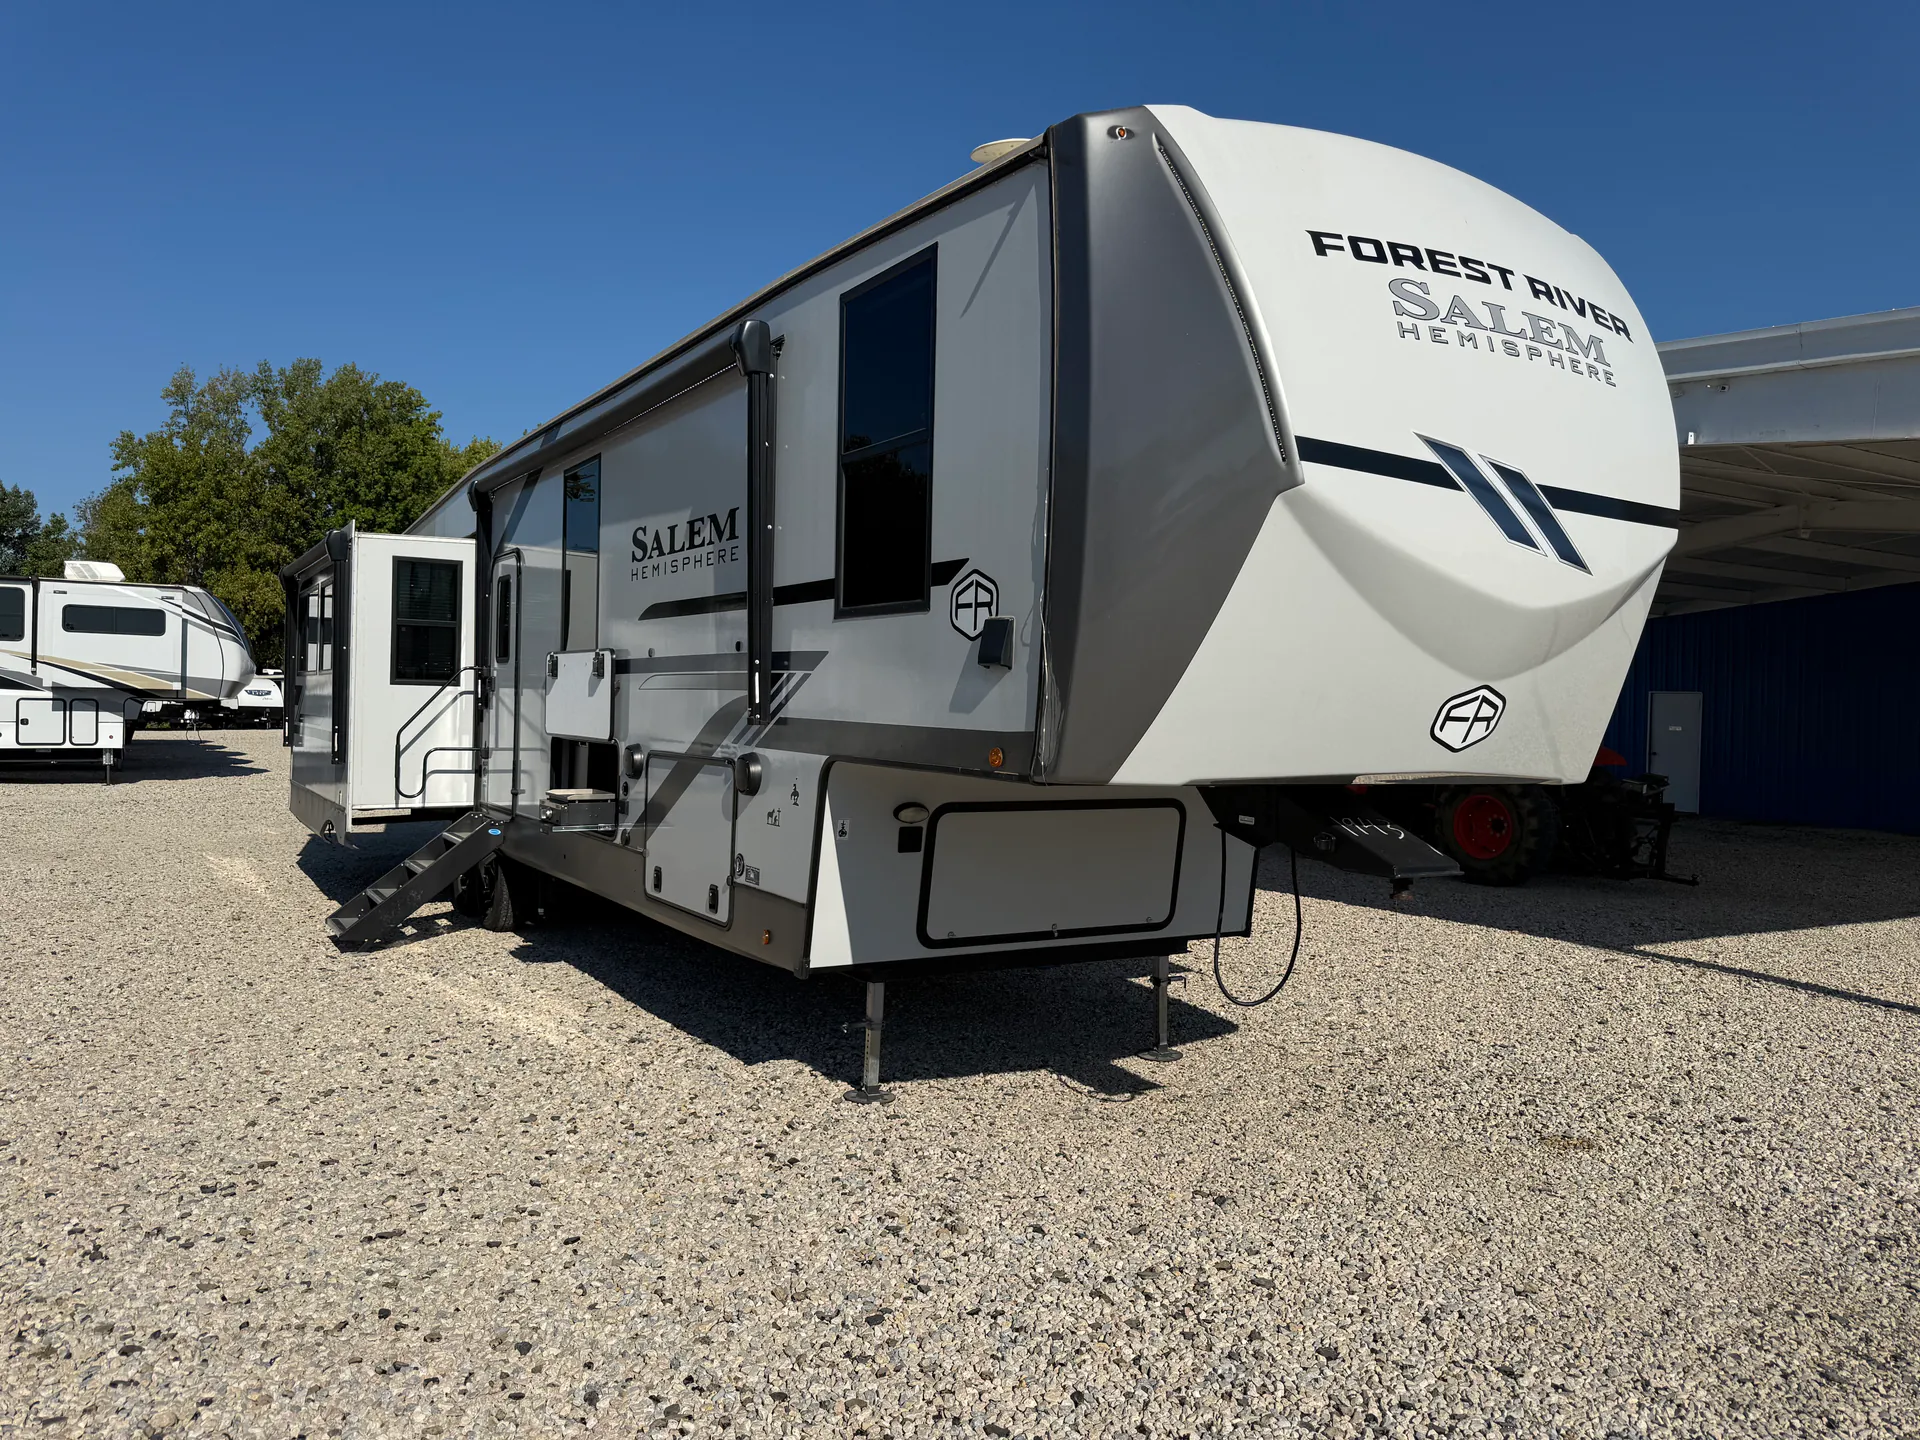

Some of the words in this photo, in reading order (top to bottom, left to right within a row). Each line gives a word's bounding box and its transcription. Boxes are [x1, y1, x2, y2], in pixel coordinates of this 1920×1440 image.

[1305, 229, 1514, 291] FOREST
[1523, 273, 1634, 343] RIVER
[1388, 277, 1611, 367] SALEM
[1396, 321, 1616, 387] HEMISPHERE
[630, 545, 739, 582] HEMISPHERE
[631, 506, 740, 563] SALEM
